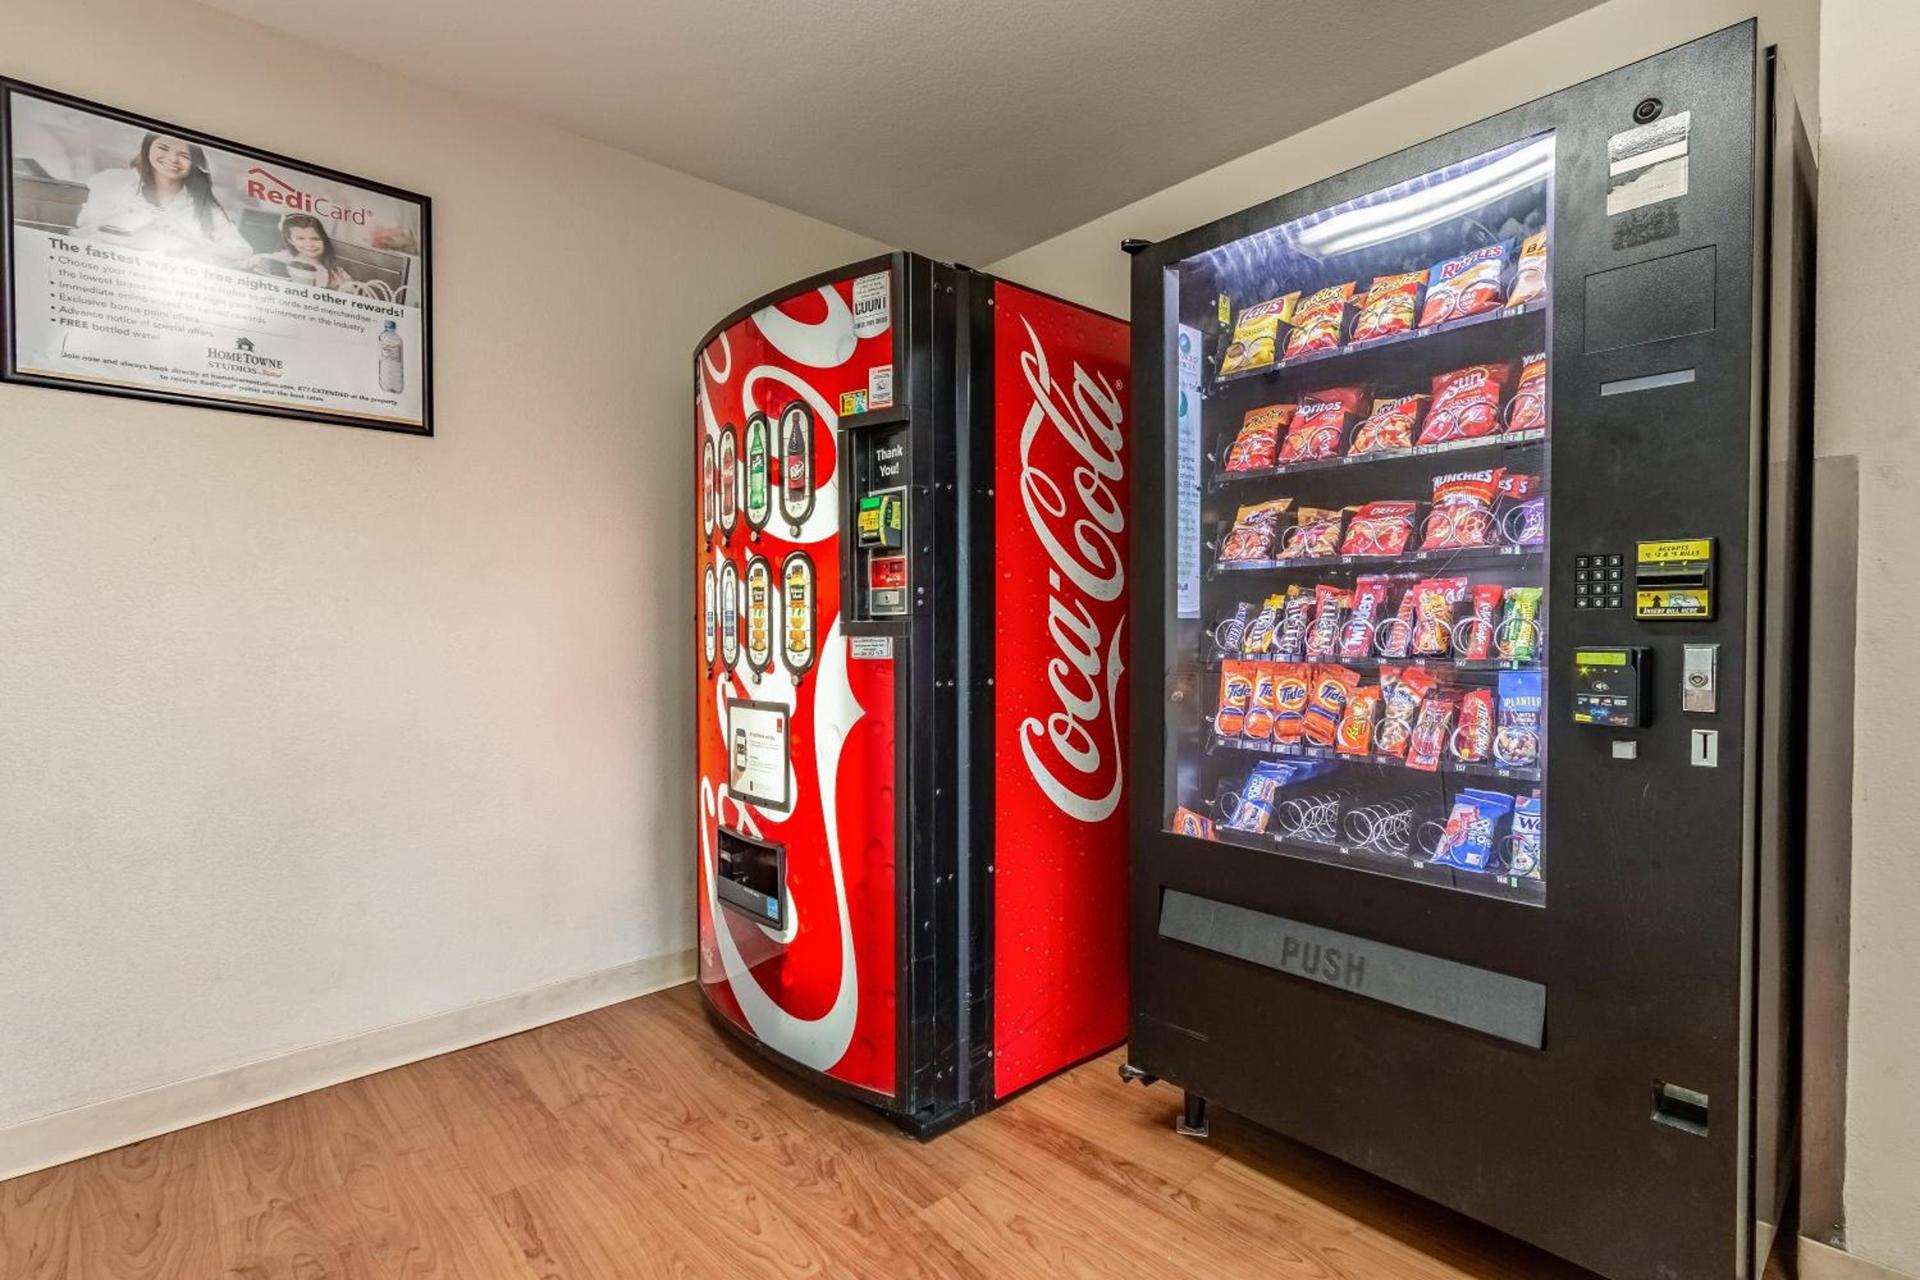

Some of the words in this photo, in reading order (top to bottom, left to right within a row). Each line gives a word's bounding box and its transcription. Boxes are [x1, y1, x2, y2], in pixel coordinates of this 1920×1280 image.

[49, 238, 80, 253] The
[85, 244, 141, 266] fastest
[145, 258, 176, 276] way
[203, 267, 233, 285] free
[237, 278, 280, 294] nights
[284, 286, 308, 299] and
[312, 291, 347, 306] other
[351, 300, 405, 318] rewards!
[59, 256, 100, 271] Choose
[303, 303, 319, 312] and
[59, 283, 114, 297] Immediate
[58, 268, 76, 279] the
[80, 271, 113, 285] lowest
[318, 316, 330, 326] the
[333, 319, 365, 333] industry
[60, 292, 107, 308] Exclusive
[110, 301, 140, 314] bonus
[60, 305, 104, 320] Advance
[107, 314, 138, 325] notice
[188, 326, 214, 338] offers
[60, 318, 89, 329] FREE
[92, 322, 131, 336] bottled
[102, 358, 118, 366] and
[207, 360, 258, 375] STUDIOS
[262, 388, 275, 396] and
[277, 389, 288, 398] the
[1436, 373, 1482, 408] Sun
[1296, 401, 1342, 416] Doritos
[876, 444, 903, 462] Thank
[880, 462, 899, 477] You!
[1432, 469, 1493, 488] MUNCHIES
[1228, 683, 1251, 698] Tide
[1279, 686, 1305, 703] Tide
[1320, 685, 1346, 704] Tide
[1280, 936, 1366, 989] PUSH
